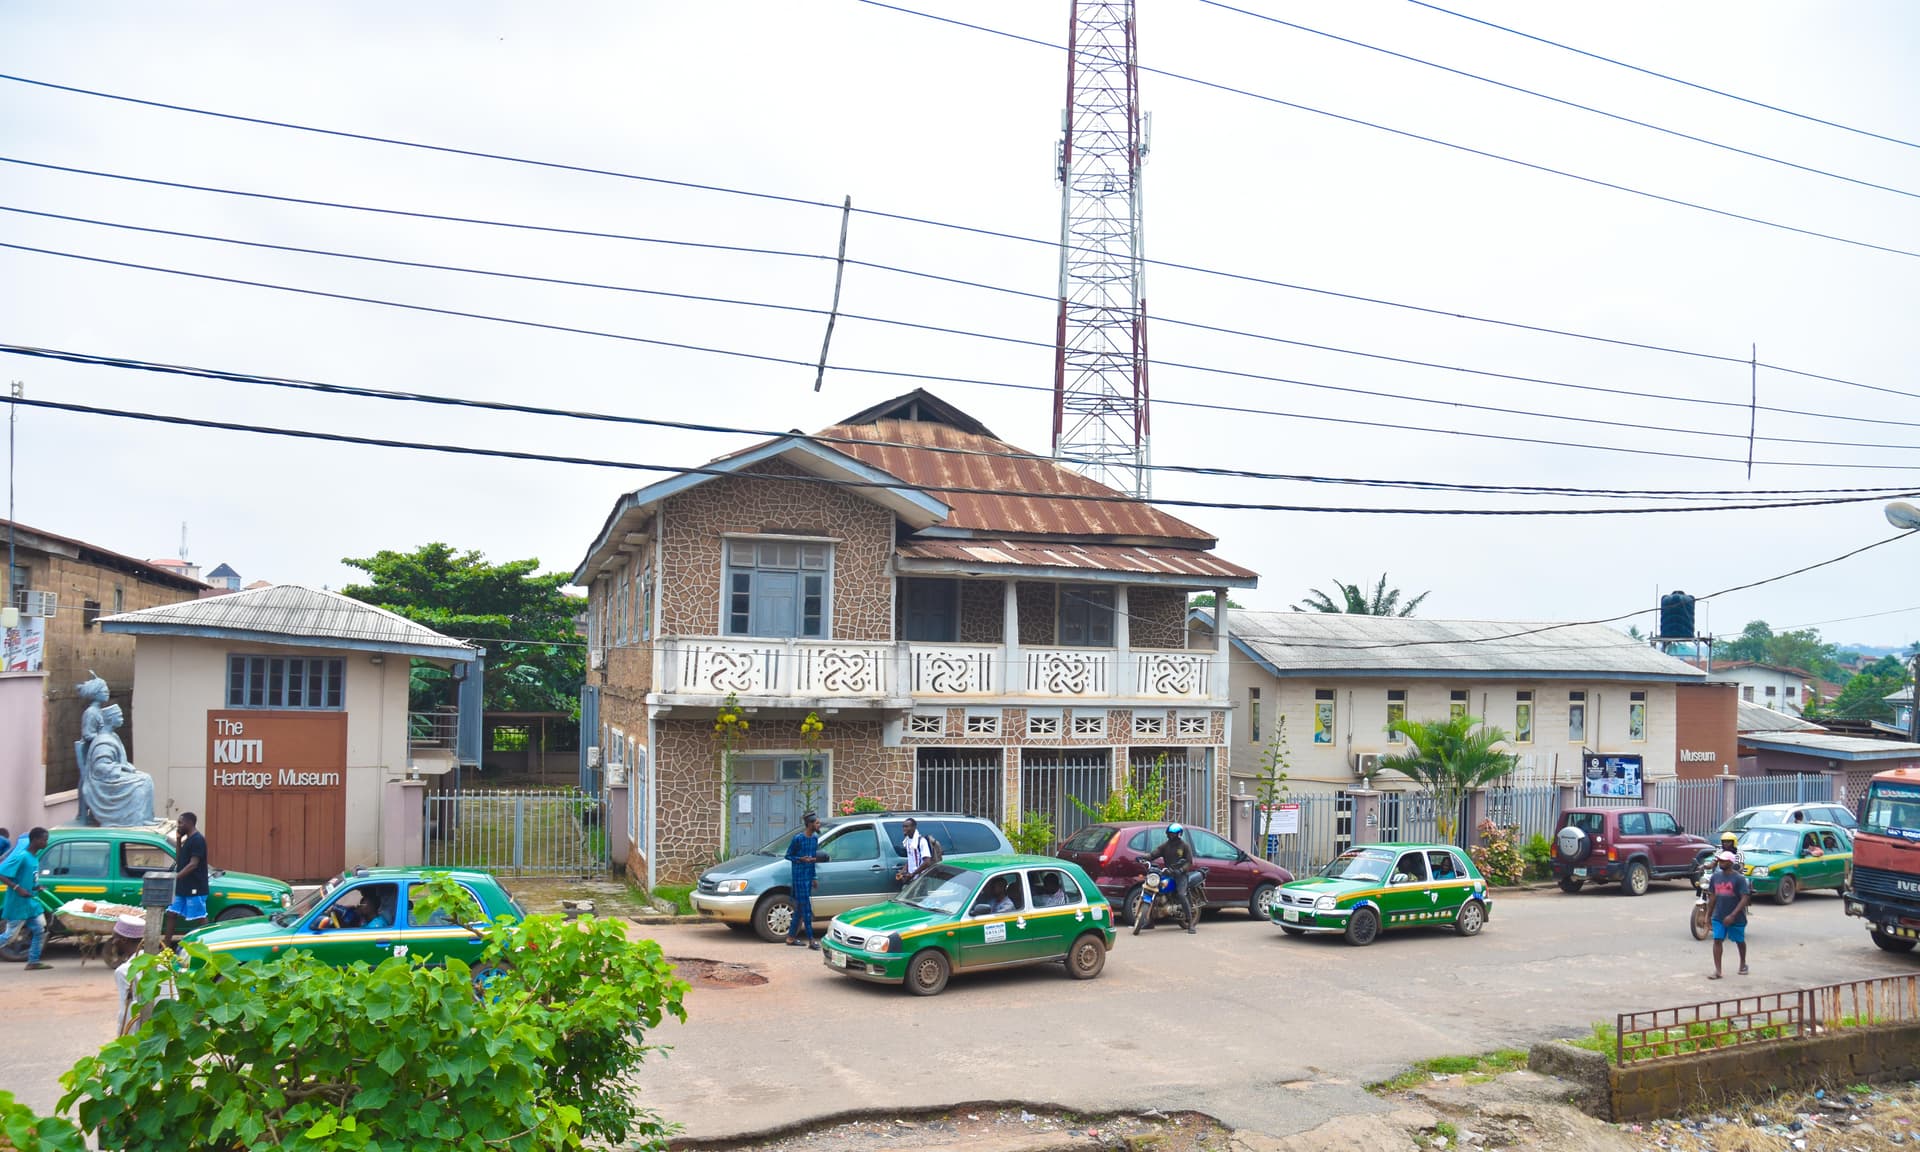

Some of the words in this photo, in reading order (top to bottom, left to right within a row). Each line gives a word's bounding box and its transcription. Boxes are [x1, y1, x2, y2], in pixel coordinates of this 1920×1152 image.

[214, 719, 244, 736] The
[213, 739, 263, 763] KUTI
[1680, 749, 1716, 762] Museum
[213, 769, 272, 789] Heritage
[278, 768, 340, 786] Museum
